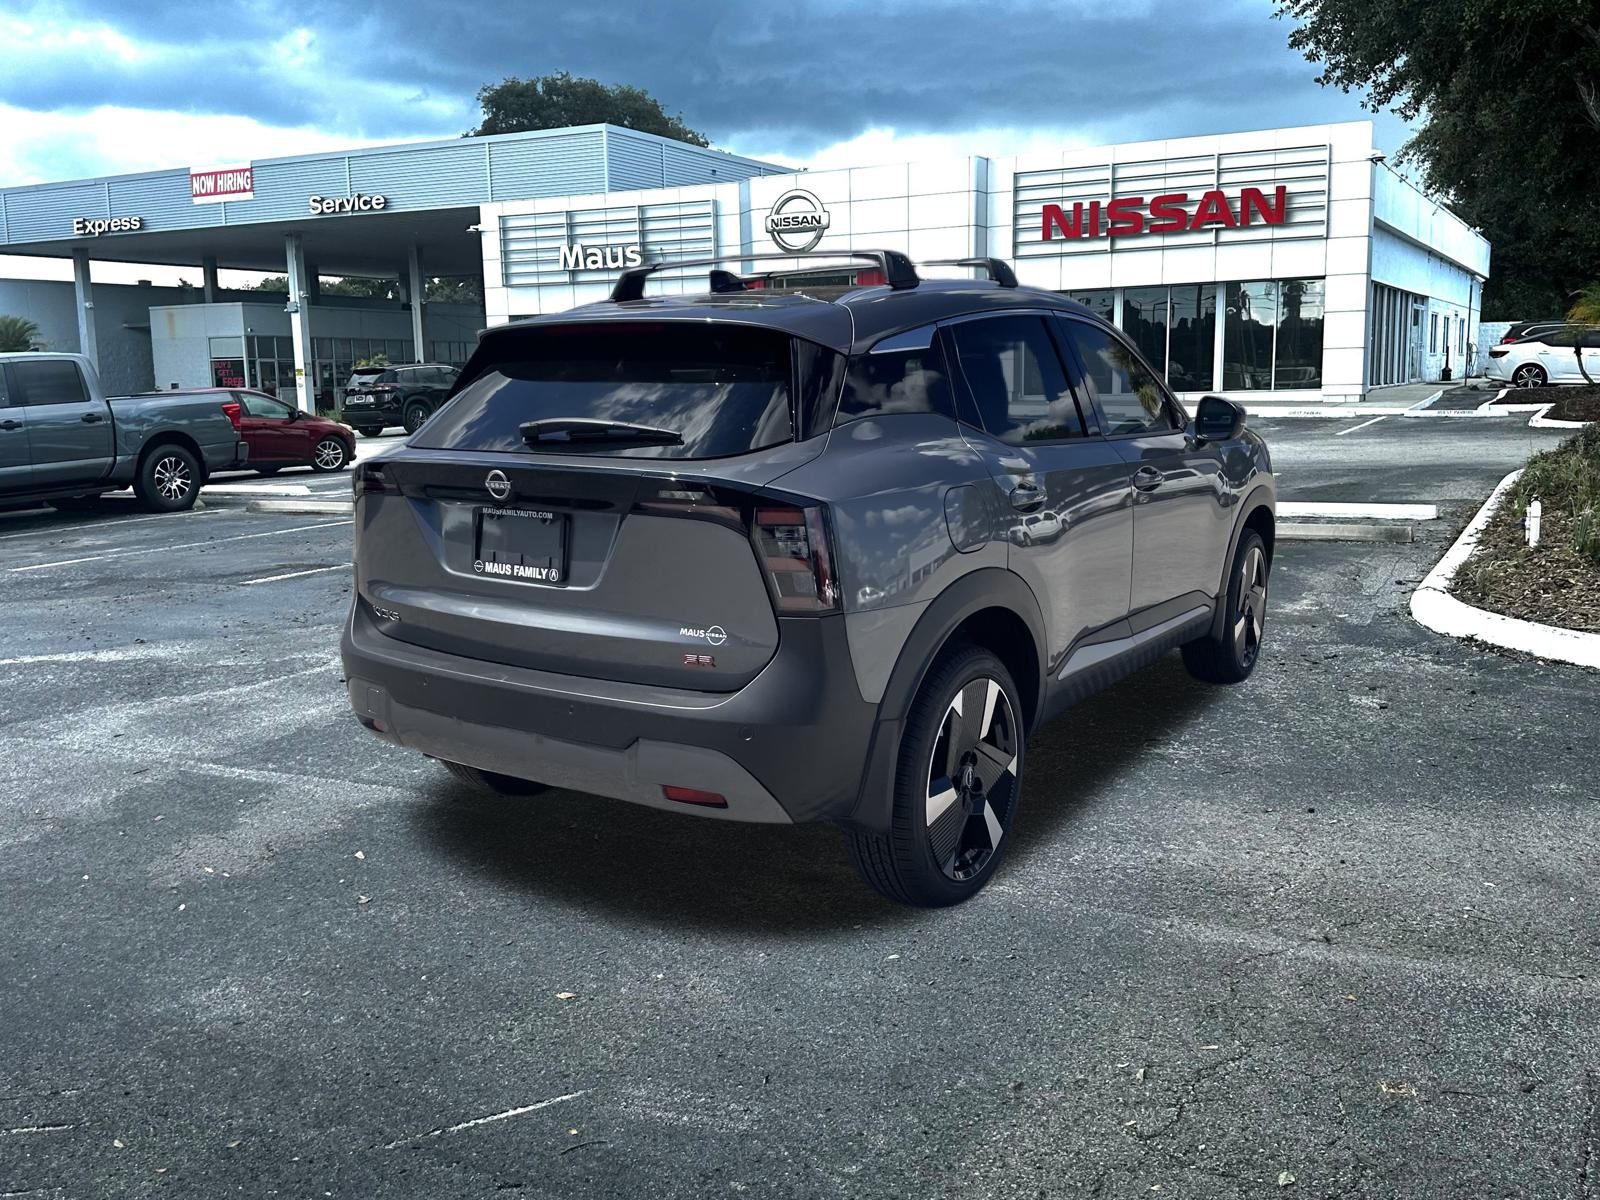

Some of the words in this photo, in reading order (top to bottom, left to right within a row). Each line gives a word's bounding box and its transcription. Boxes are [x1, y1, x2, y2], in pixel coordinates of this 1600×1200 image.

[192, 175, 216, 195] NOW
[217, 171, 251, 192] HIRING
[309, 193, 385, 215] Service
[1042, 185, 1286, 241] NISSAN
[72, 216, 141, 236] Express
[770, 215, 822, 229] NISSAN
[559, 243, 642, 270] Maus
[222, 377, 245, 387] FREE
[482, 507, 553, 519] MAUSFAMILYAUTO.COM
[485, 562, 512, 575] MAUS
[513, 565, 548, 579] FAMILY
[680, 627, 705, 638] MAUS
